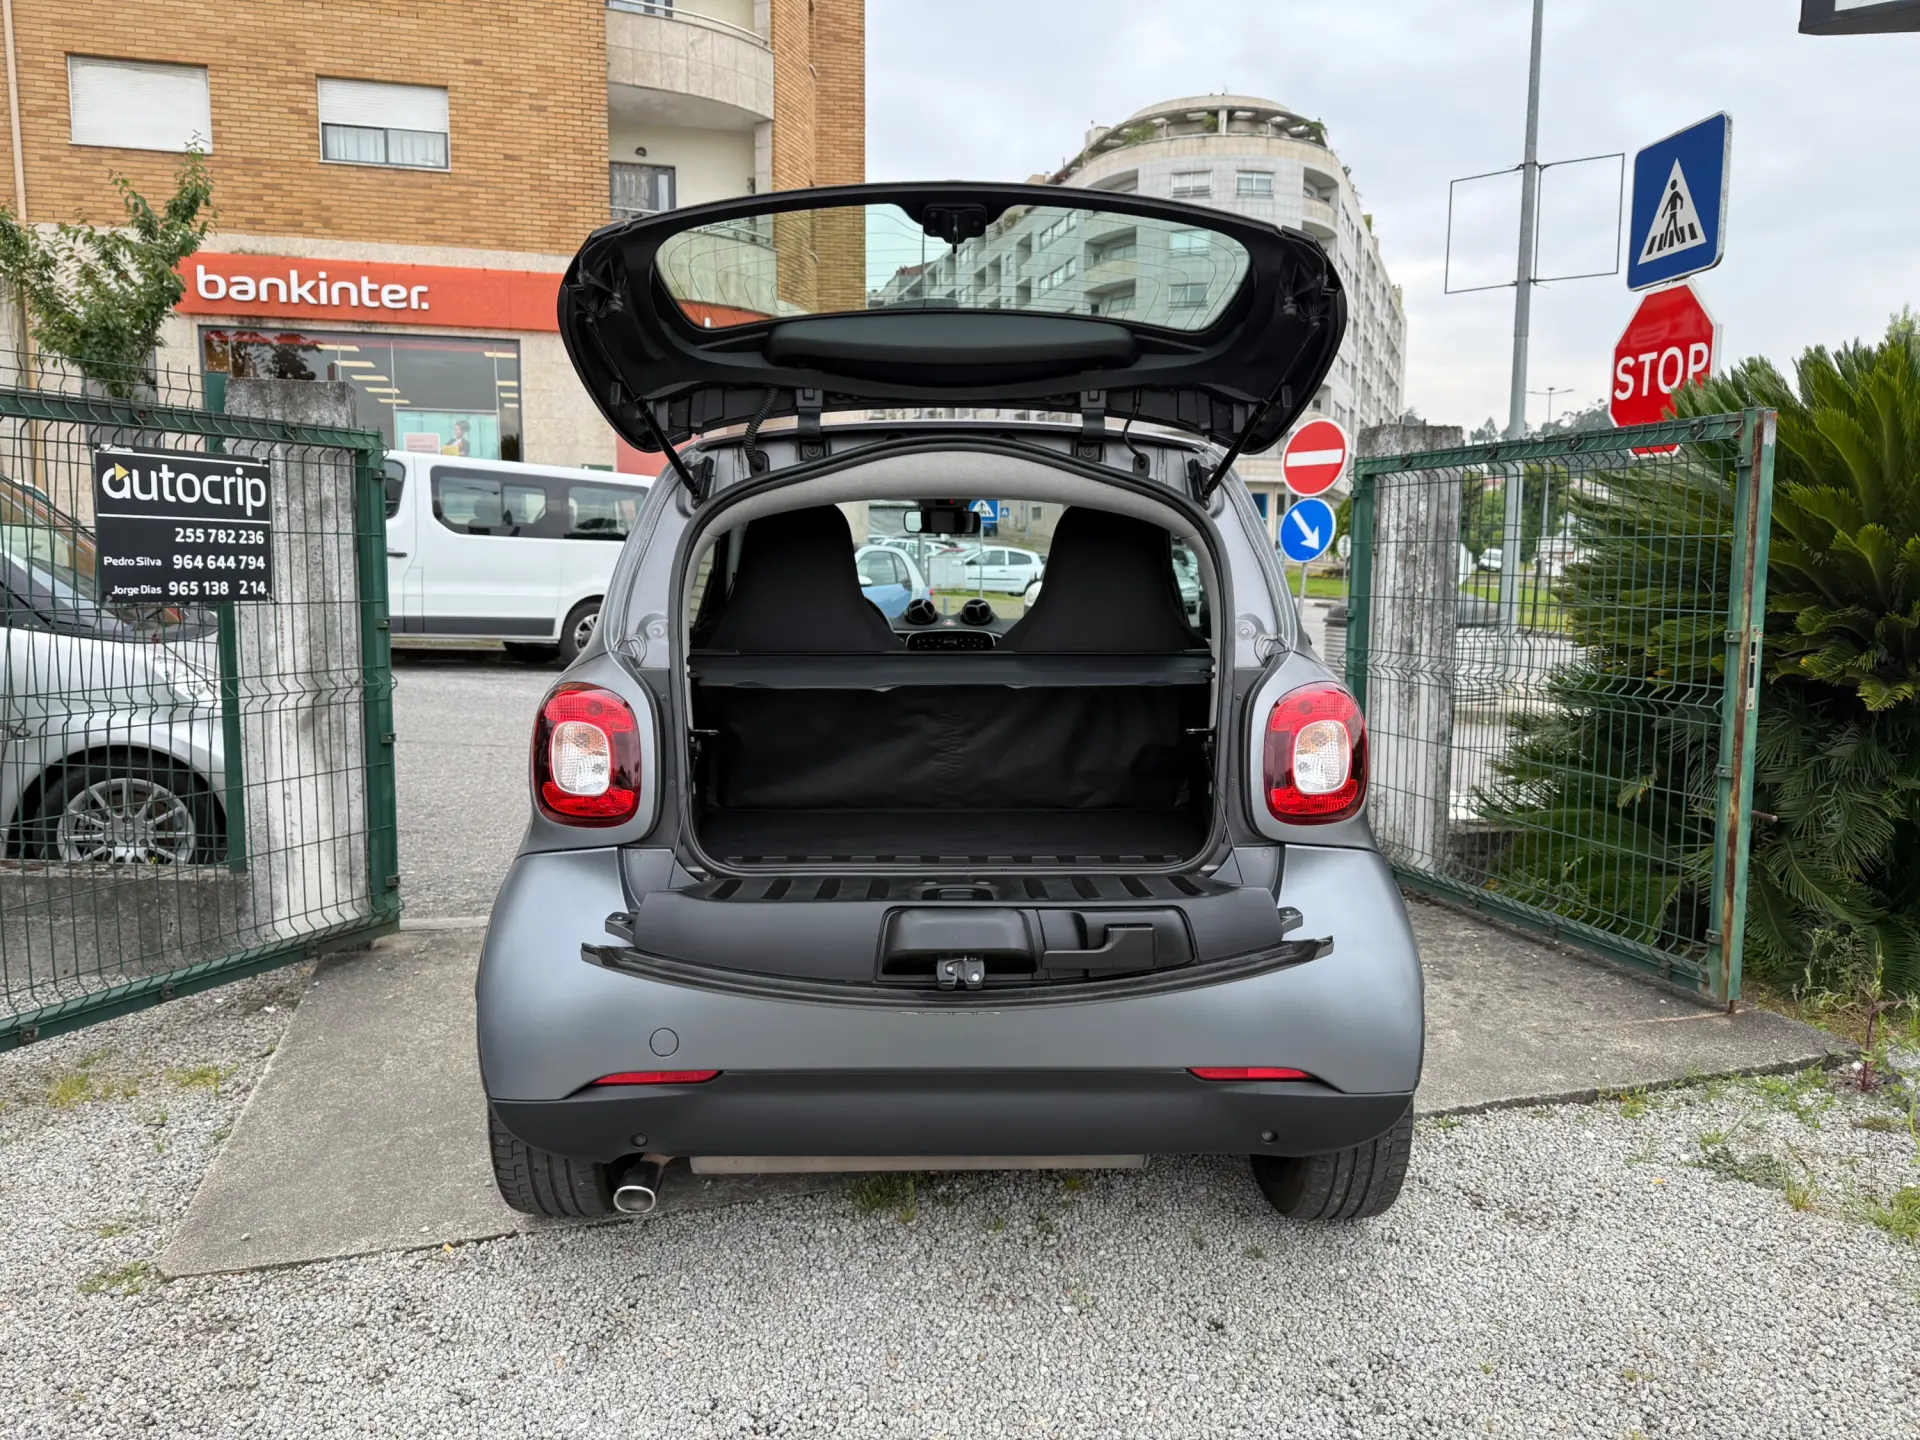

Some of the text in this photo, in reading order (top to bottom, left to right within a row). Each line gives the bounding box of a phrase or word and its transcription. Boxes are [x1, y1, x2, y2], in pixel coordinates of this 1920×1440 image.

[1614, 341, 1709, 401] STOP
[102, 463, 267, 517] autocrip
[175, 527, 265, 545] 255 782 236
[103, 554, 266, 570] Pedro Silva 964 644 794
[111, 580, 267, 596] Jorge Dias 965 138 214
